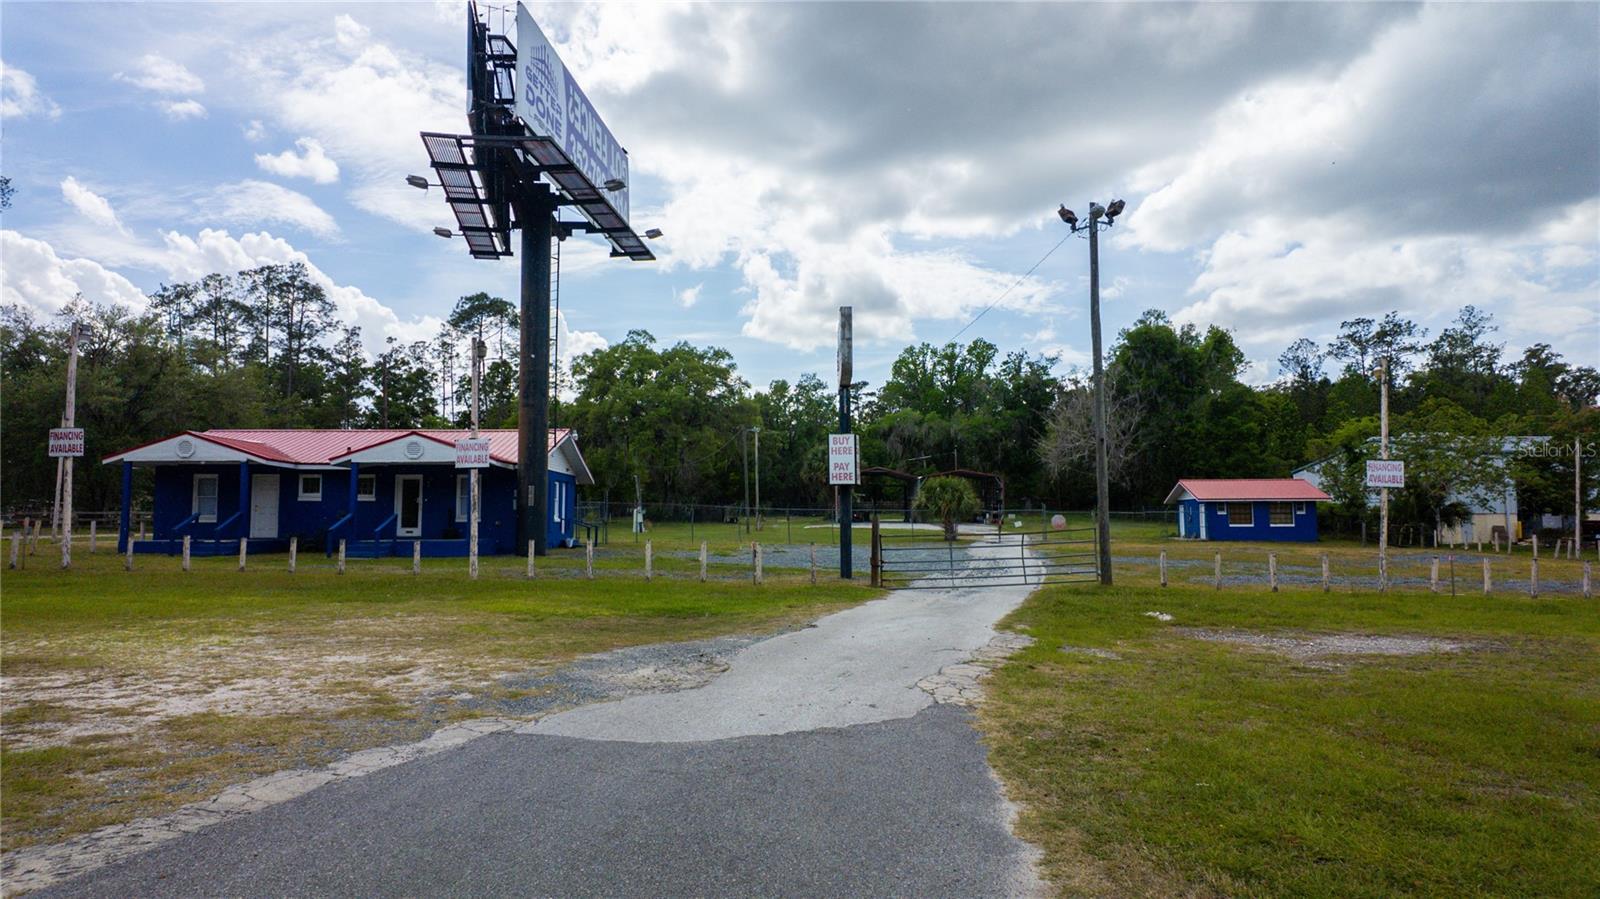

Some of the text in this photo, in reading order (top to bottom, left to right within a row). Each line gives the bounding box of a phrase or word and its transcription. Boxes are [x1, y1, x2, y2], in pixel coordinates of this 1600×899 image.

[525, 65, 562, 120] GETTER
[525, 84, 562, 140] DONE
[50, 431, 83, 441] FINANCING
[832, 436, 850, 446] BUY
[50, 444, 83, 454] AVAILABLE
[455, 442, 489, 452] FINANCING
[831, 446, 853, 456] HERE
[456, 454, 488, 464] AVAILABLE
[833, 462, 850, 471] PAY
[1368, 462, 1403, 473] FINANCING
[831, 472, 854, 481] HERE
[1368, 474, 1403, 484] AVAILABLE
